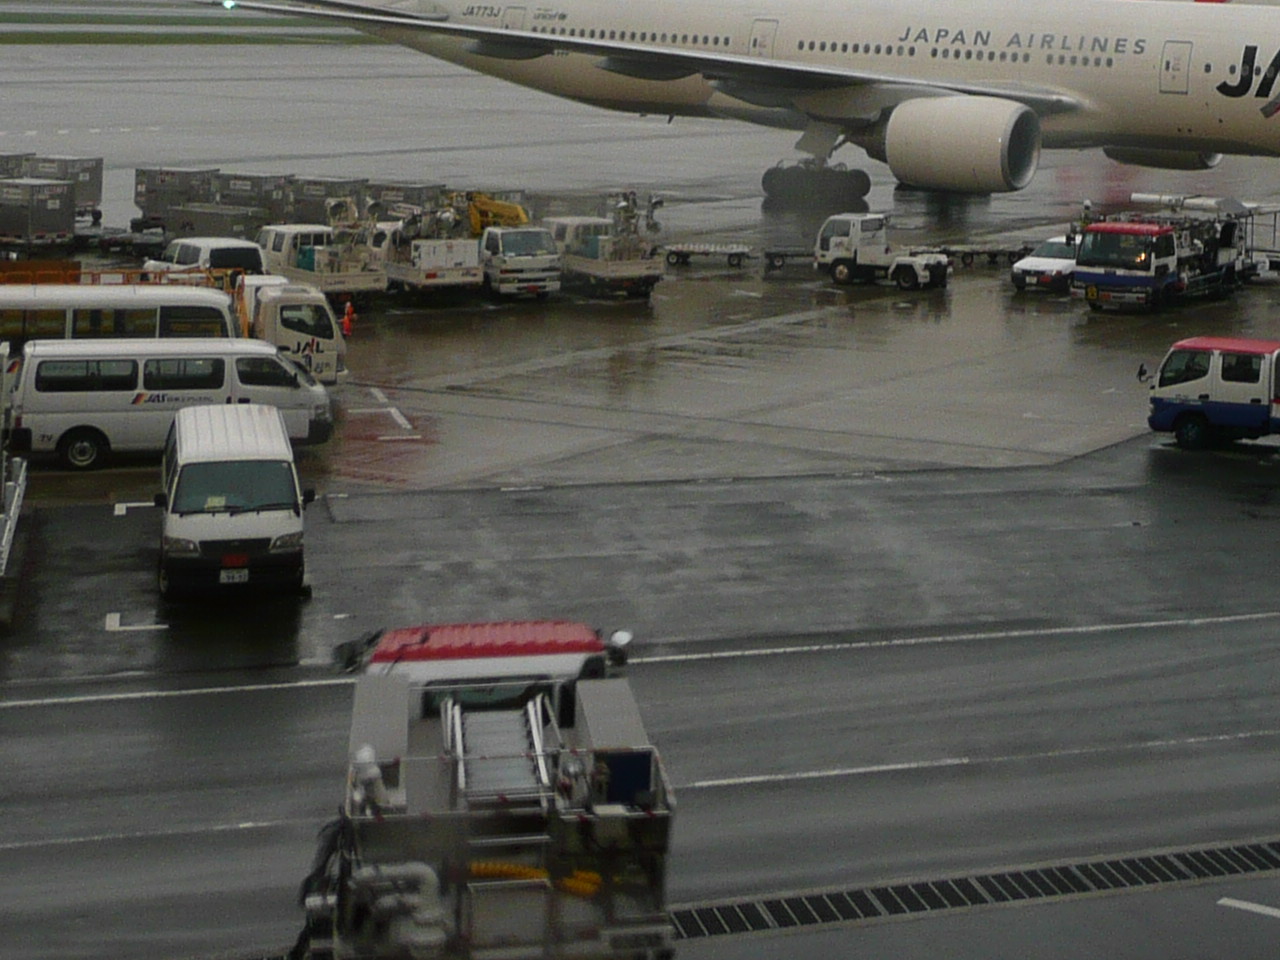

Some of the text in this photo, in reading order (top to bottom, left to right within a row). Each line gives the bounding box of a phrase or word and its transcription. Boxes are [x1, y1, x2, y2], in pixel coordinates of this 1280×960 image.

[462, 5, 502, 18] JA773J
[898, 26, 1147, 55] JAPAN AIRLINES
[291, 337, 325, 354] JAL
